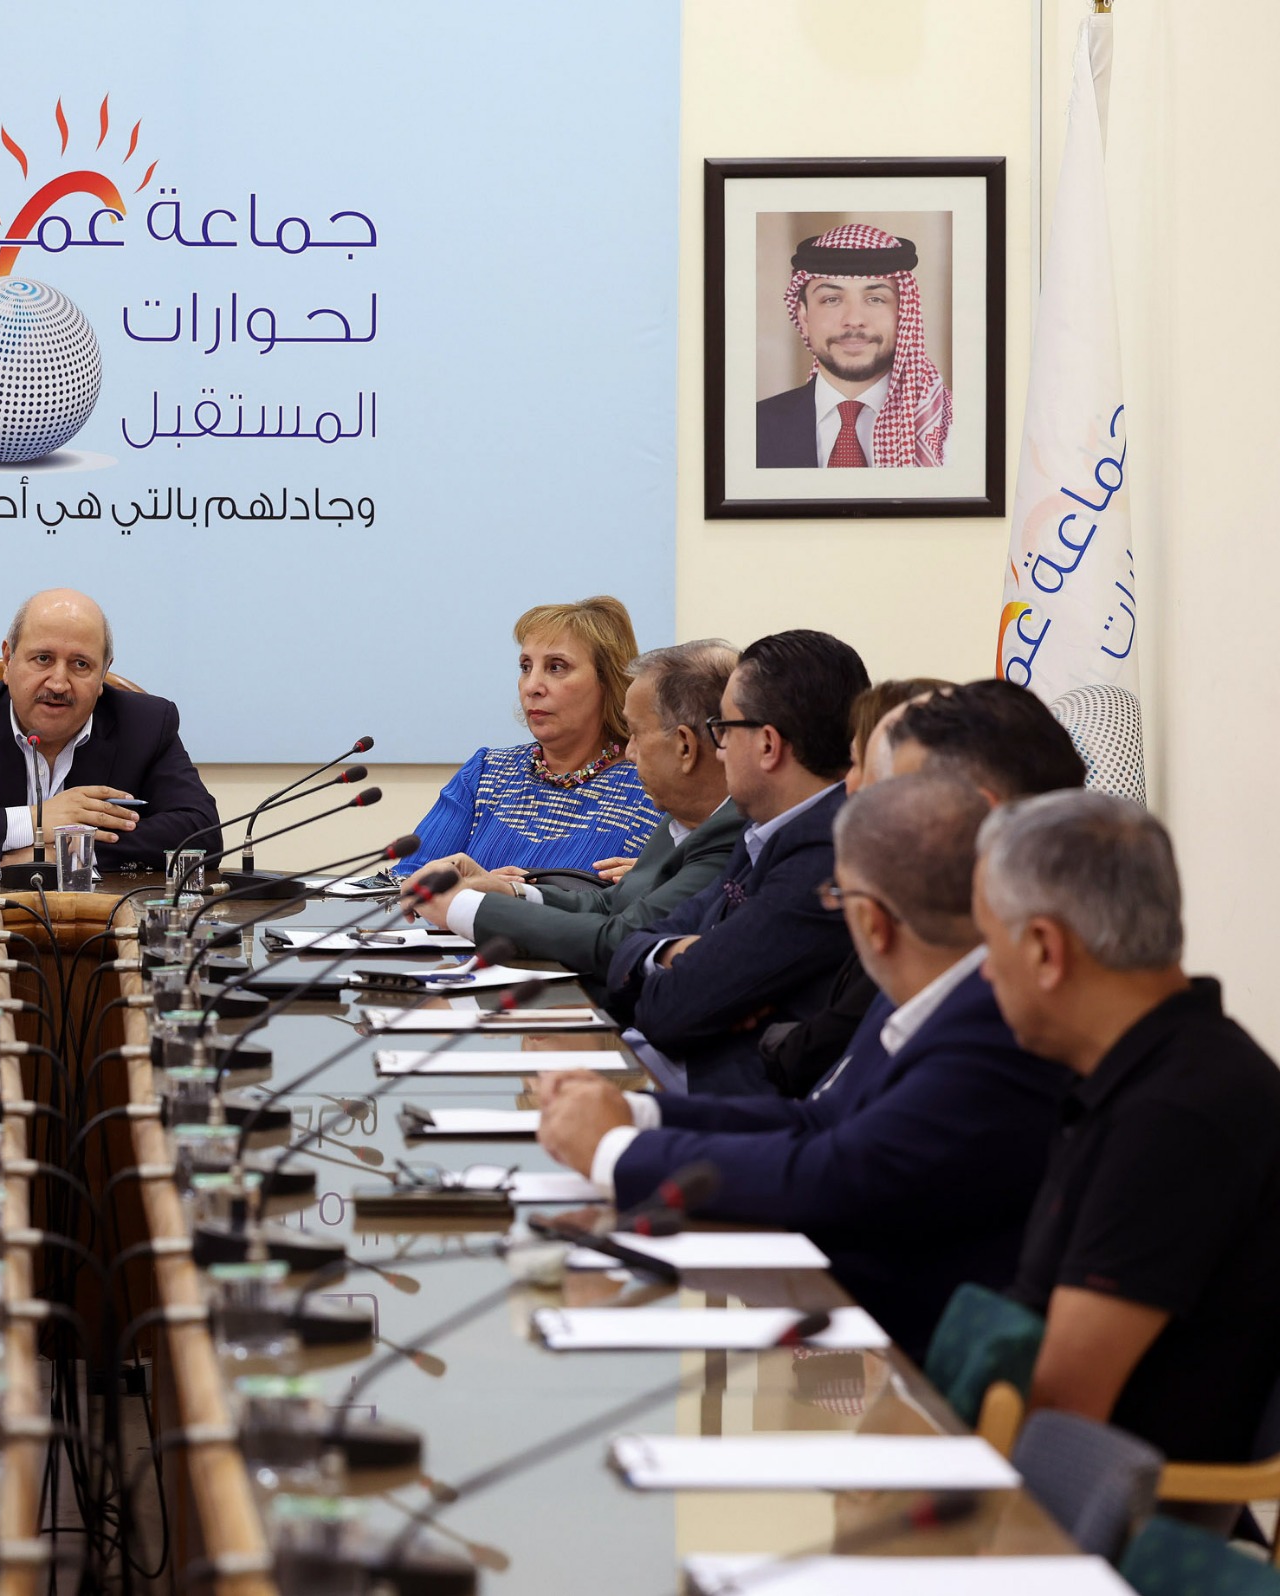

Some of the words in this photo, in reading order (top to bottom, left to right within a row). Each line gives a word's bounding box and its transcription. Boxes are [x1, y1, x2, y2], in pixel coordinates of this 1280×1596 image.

[145, 187, 378, 261] جماعة
[122, 291, 378, 356] لحوارات
[120, 387, 377, 450] المستقبل
[36, 490, 103, 536] هي
[111, 486, 198, 536] بالتي
[203, 486, 376, 529] وجادلهم
[1005, 608, 1052, 688] عم
